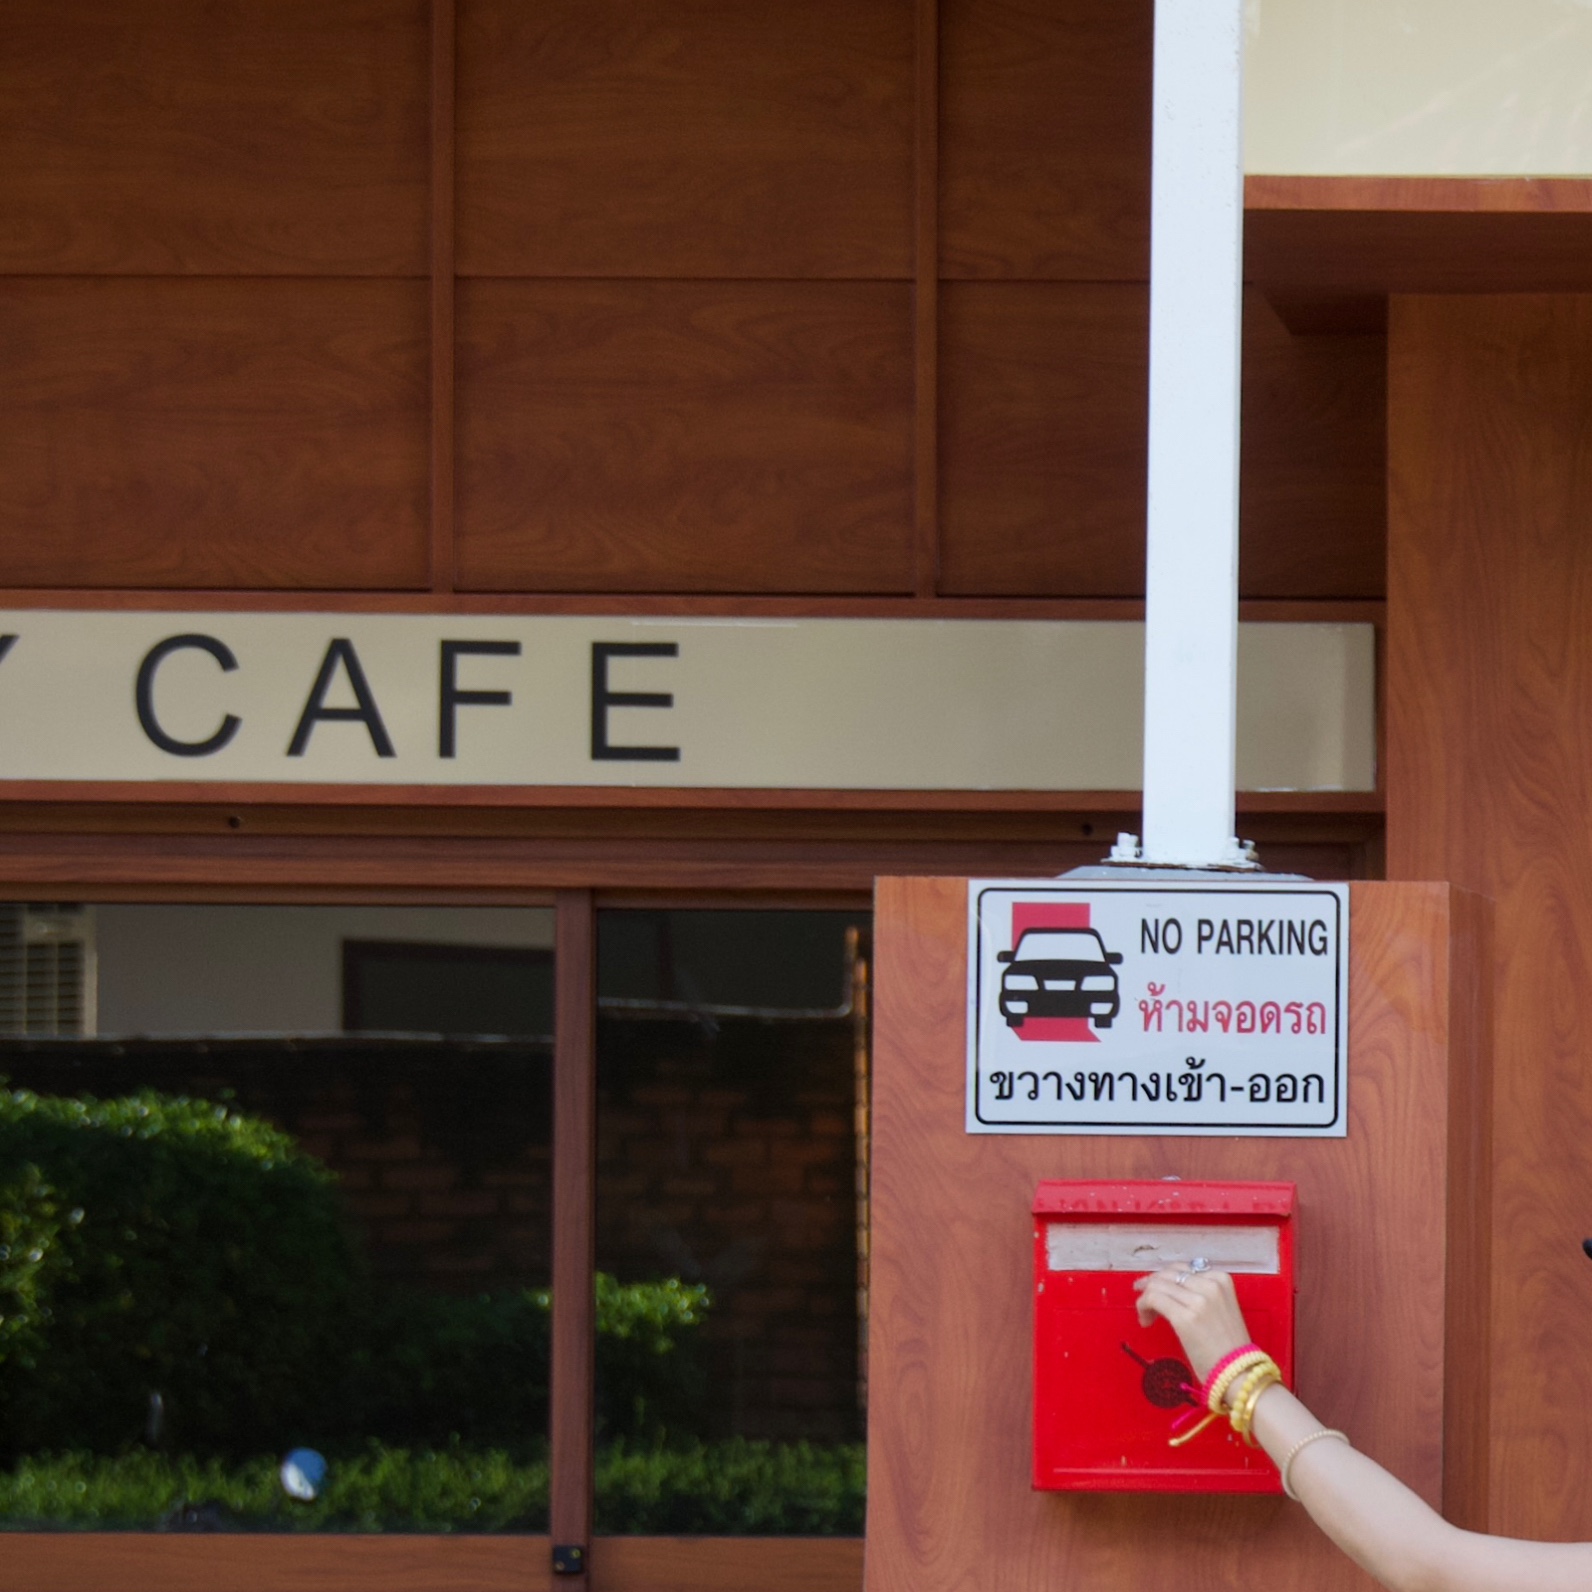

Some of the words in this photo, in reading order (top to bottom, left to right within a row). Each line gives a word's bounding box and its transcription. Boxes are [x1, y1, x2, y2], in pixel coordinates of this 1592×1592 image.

[134, 632, 682, 764] CAFE
[1140, 917, 1183, 956] NO
[1197, 917, 1329, 957] PARKING
[1138, 981, 1327, 1035] ห้ามจอดรถ
[989, 1056, 1326, 1105] ขวางทางเข้า-ออก
